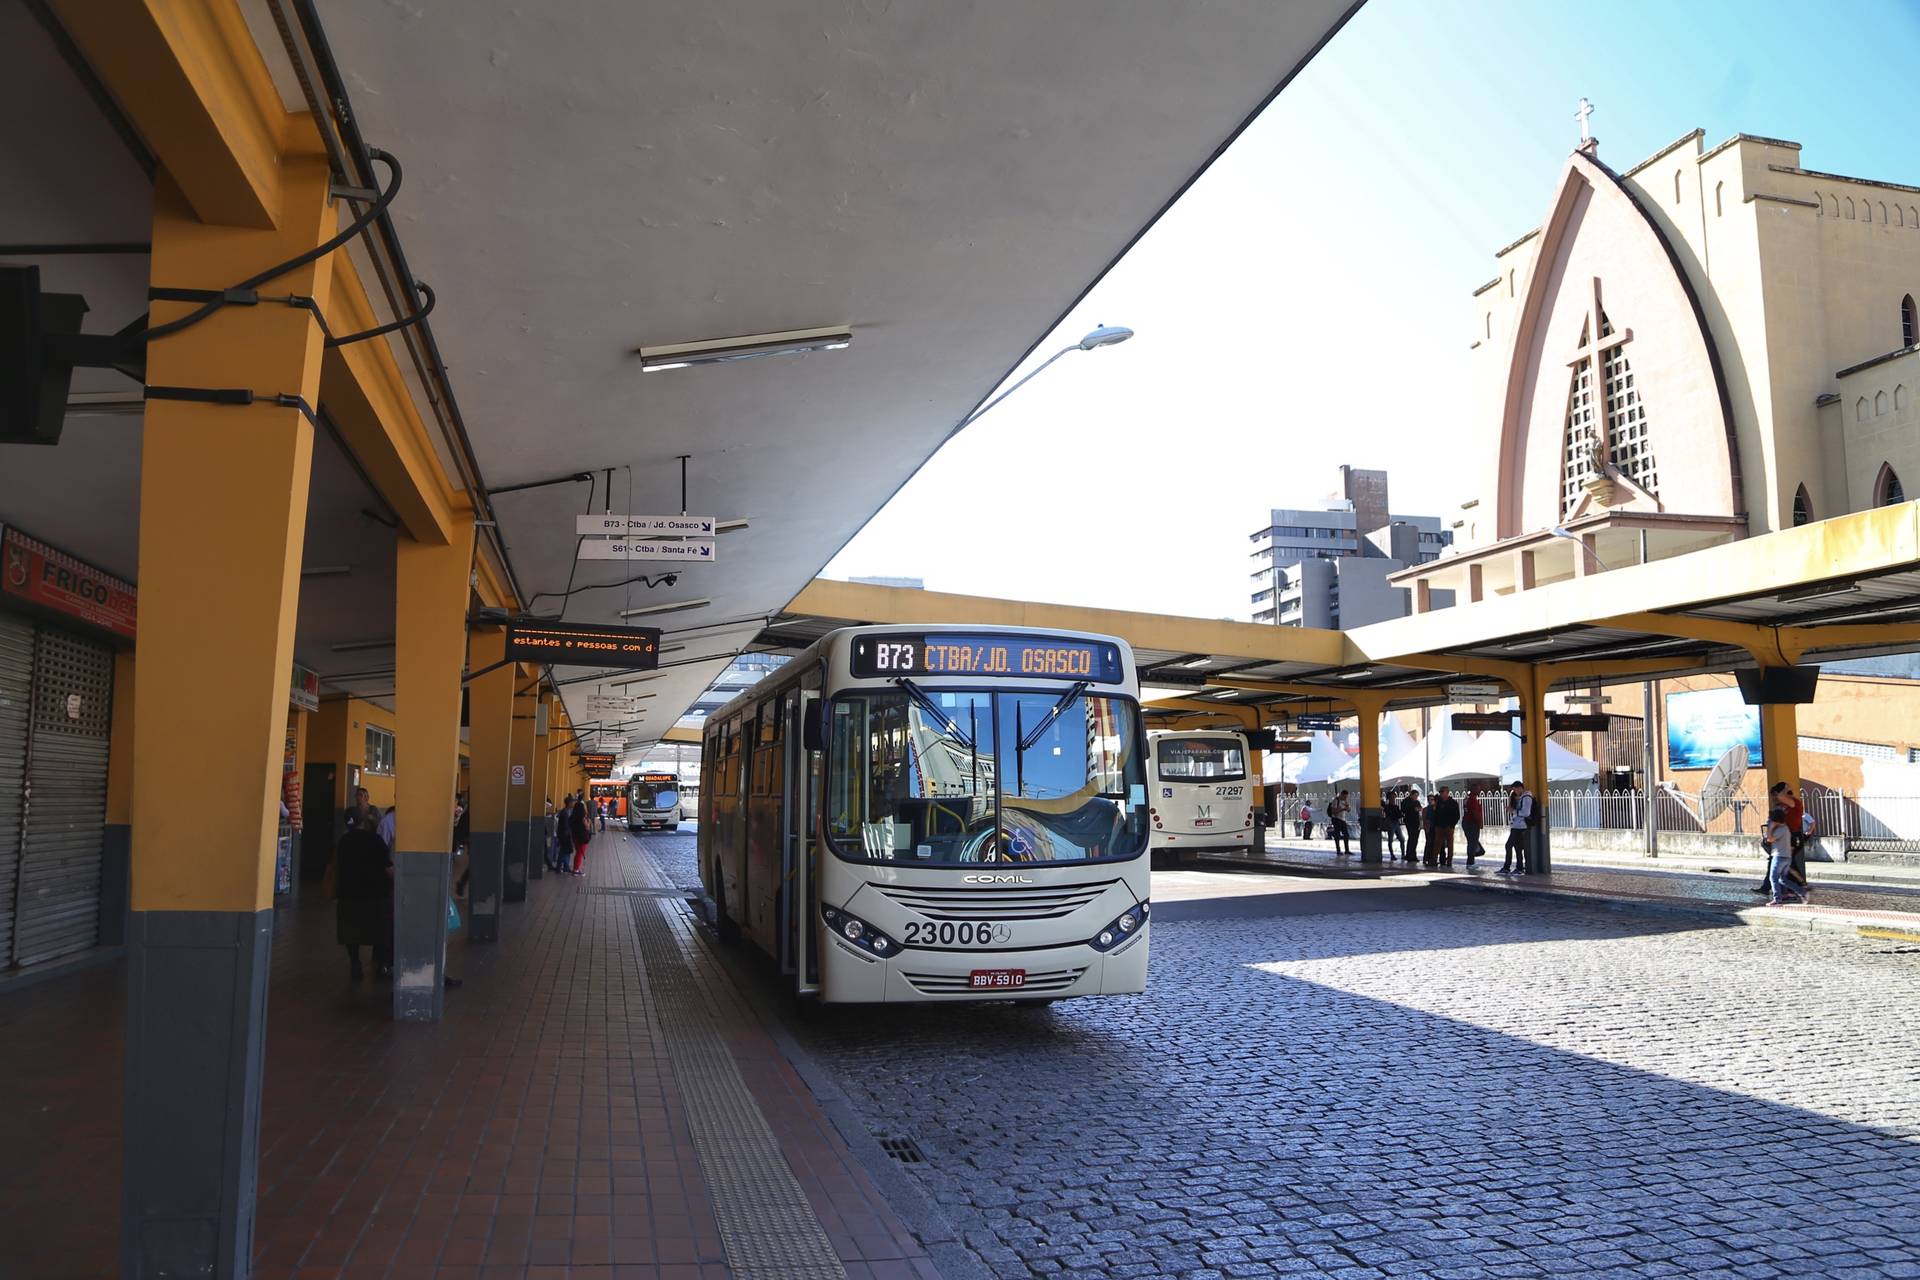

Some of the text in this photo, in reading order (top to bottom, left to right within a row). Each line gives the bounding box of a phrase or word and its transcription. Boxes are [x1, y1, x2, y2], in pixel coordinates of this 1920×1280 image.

[604, 520, 620, 528] B73
[627, 520, 647, 528] Ctba
[654, 521, 667, 529] Jd.
[668, 521, 699, 529] Osasco
[635, 545, 655, 553] Ctba
[662, 545, 685, 554] Santa
[687, 546, 698, 554] Fe
[514, 637, 561, 647] estantes
[565, 640, 573, 648] e
[622, 643, 641, 652] com
[876, 643, 915, 669] B73
[1021, 648, 1092, 674] OSASCO
[1215, 786, 1244, 796] 27297
[963, 875, 1033, 884] COMIL
[904, 922, 992, 945] 23006
